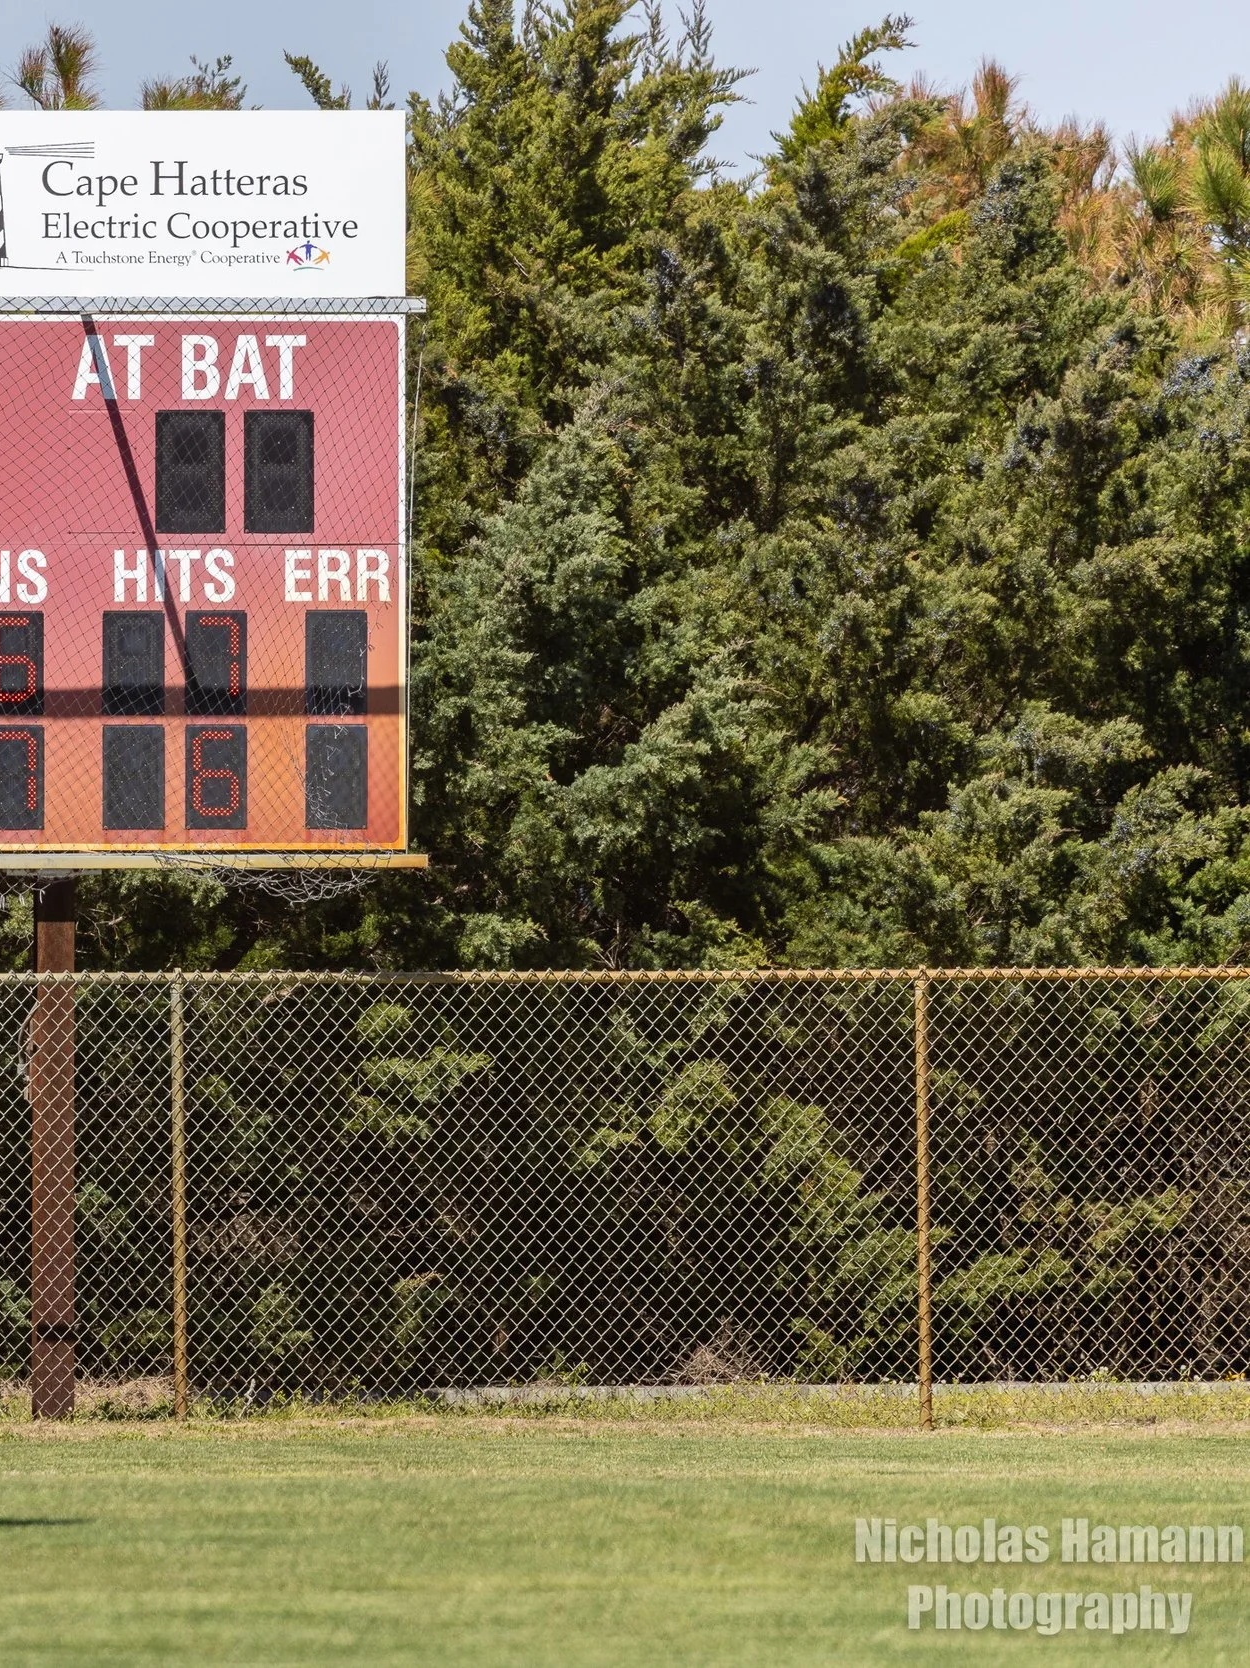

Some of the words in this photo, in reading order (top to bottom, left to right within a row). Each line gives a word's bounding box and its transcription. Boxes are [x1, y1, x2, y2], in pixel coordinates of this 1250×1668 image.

[41, 160, 139, 207] Cape
[149, 160, 308, 197] Hatteras
[41, 211, 157, 239] Electric
[166, 211, 359, 248] Cooperative
[55, 251, 68, 264] A
[71, 250, 145, 264] Touchstone
[200, 250, 281, 267] Cooperative
[71, 333, 155, 401] AT
[180, 333, 306, 401] BAT
[113, 548, 236, 603] HITS
[283, 548, 392, 603] ERR
[199, 616, 240, 696] 7
[192, 730, 240, 817] 6
